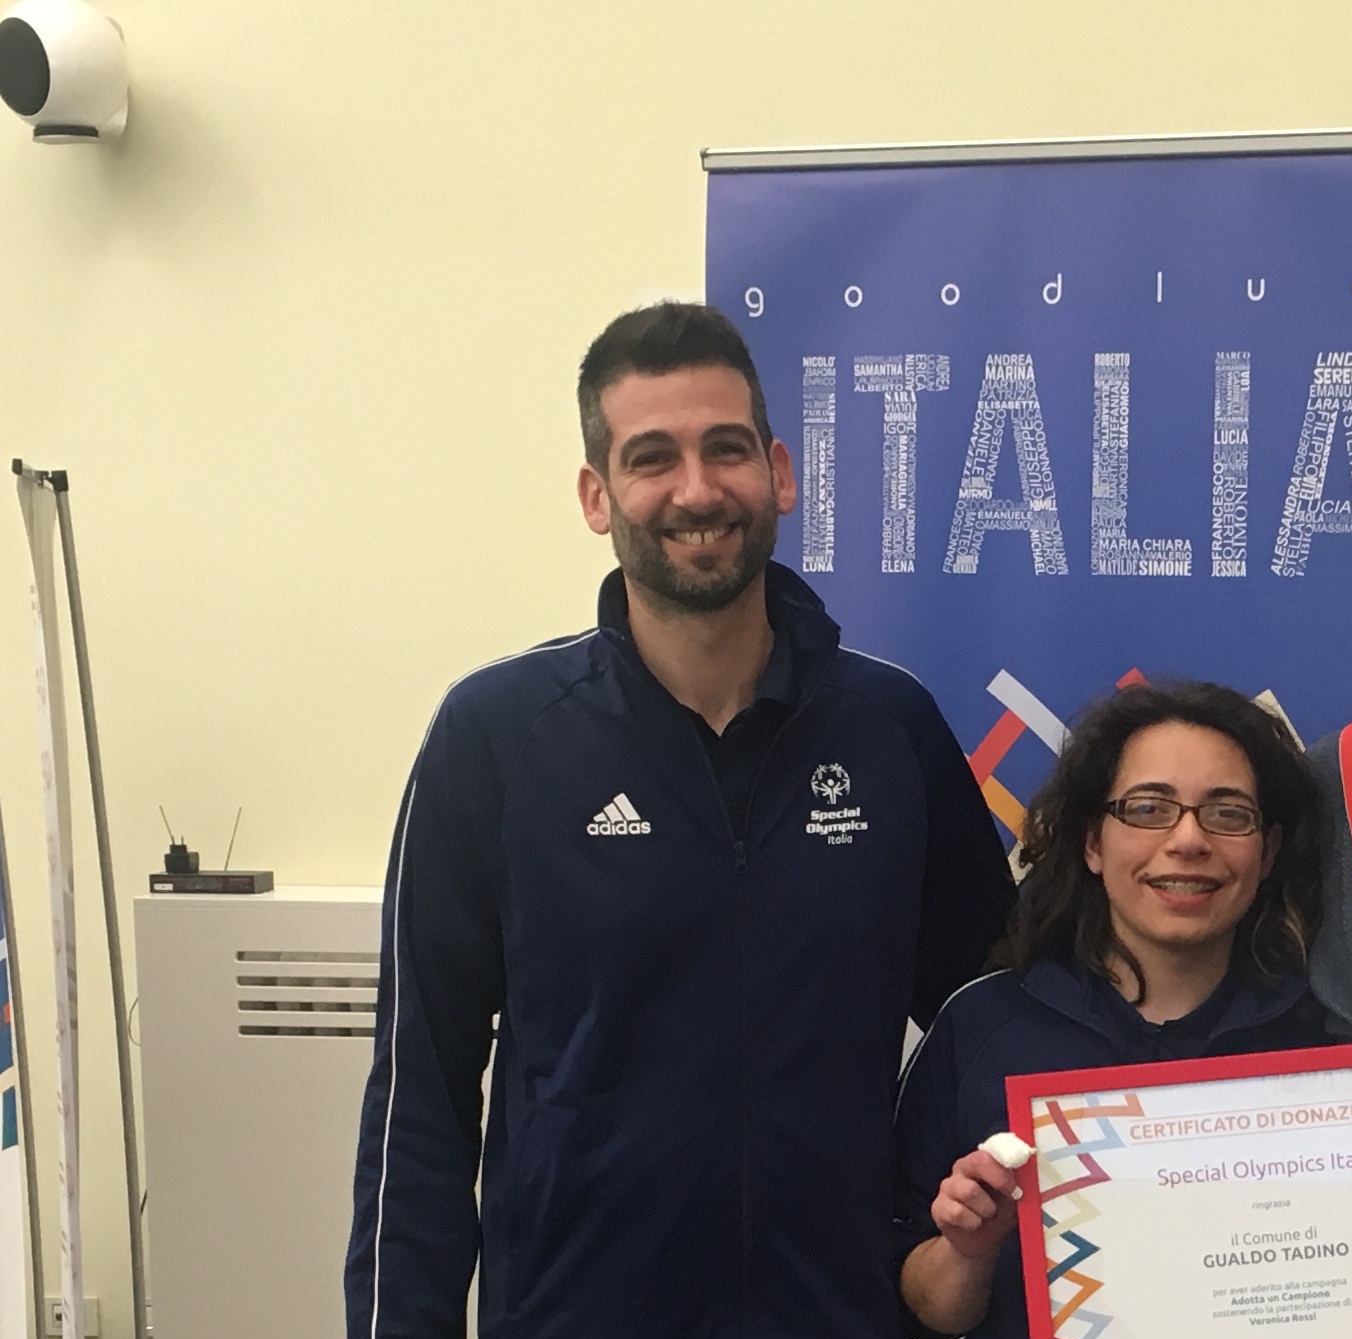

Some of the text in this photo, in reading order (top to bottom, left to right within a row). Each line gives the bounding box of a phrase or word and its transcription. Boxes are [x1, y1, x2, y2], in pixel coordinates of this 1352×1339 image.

[986, 354, 1033, 366] ANDREA
[1094, 353, 1130, 366] ROBERTO
[853, 363, 903, 376] SAMANTHA
[904, 354, 915, 391] AUSTIN
[915, 354, 927, 391] ERICA
[936, 354, 950, 391] ANDREA
[985, 365, 1035, 380] MARINA
[853, 384, 904, 392] ALBERTO
[981, 380, 1037, 391] MARTINO
[884, 391, 916, 402] SARA
[979, 390, 1039, 401] PATRIZIA
[977, 401, 1041, 409] ELISABETTA
[1306, 398, 1340, 411] LARA
[1011, 409, 1042, 420] LUCA
[1109, 383, 1120, 448] STEFANIA
[1119, 385, 1130, 448] GIACOMO
[883, 422, 917, 434] IGOR
[972, 410, 996, 476] DANIELE
[1214, 430, 1249, 445] LUCIA
[1292, 411, 1316, 475] ROBERTO
[1304, 410, 1331, 477] FILIPPO
[984, 409, 1007, 490] FRANCESCO
[1020, 420, 1045, 499] GIUSEPPE
[1033, 420, 1057, 499] LEONARDO
[898, 435, 908, 510] MARIAGIULIA
[959, 488, 993, 500] MIRKO
[977, 511, 1033, 520] EMANUELE
[1211, 463, 1224, 560] FRANCESCO
[1223, 477, 1236, 559] ROBERTO
[1234, 477, 1248, 559] SIMONE
[826, 499, 835, 556] GABRIELE
[1099, 528, 1127, 538] MARIA
[1271, 477, 1302, 576] ALESSANDRA
[943, 500, 966, 574] FRANCESCO
[1100, 539, 1192, 551] MARIA CHIARA
[1029, 529, 1046, 576] MICHAEL
[1149, 551, 1192, 560] VALERIO
[1282, 522, 1306, 577] STELLA
[802, 563, 834, 573] LUNA
[882, 560, 915, 573] ELENA
[1100, 559, 1193, 576] MATILDE SIMONE
[1210, 560, 1247, 577] JESSICA
[810, 806, 861, 822] Special
[587, 819, 651, 836] adidas
[805, 819, 869, 836] Olympics
[827, 833, 853, 845] Italia
[1129, 1114, 1251, 1141] CERTIFICATO
[1256, 1111, 1276, 1129] DI
[1157, 1162, 1228, 1188] Special
[1233, 1154, 1325, 1181] Olympics
[1252, 1198, 1291, 1210] ringrazia
[1231, 1226, 1318, 1246] il Comune di
[1203, 1242, 1350, 1268] GUALDO TADINO
[1212, 1277, 1347, 1298] per aver aderito alla campagna
[1231, 1289, 1331, 1306] Adotta un Campione
[1212, 1305, 1264, 1319] sostenendo
[1275, 1299, 1341, 1315] partecipazione
[1342, 1298, 1352, 1307] di
[1249, 1311, 1317, 1326] Veronica Rossi
